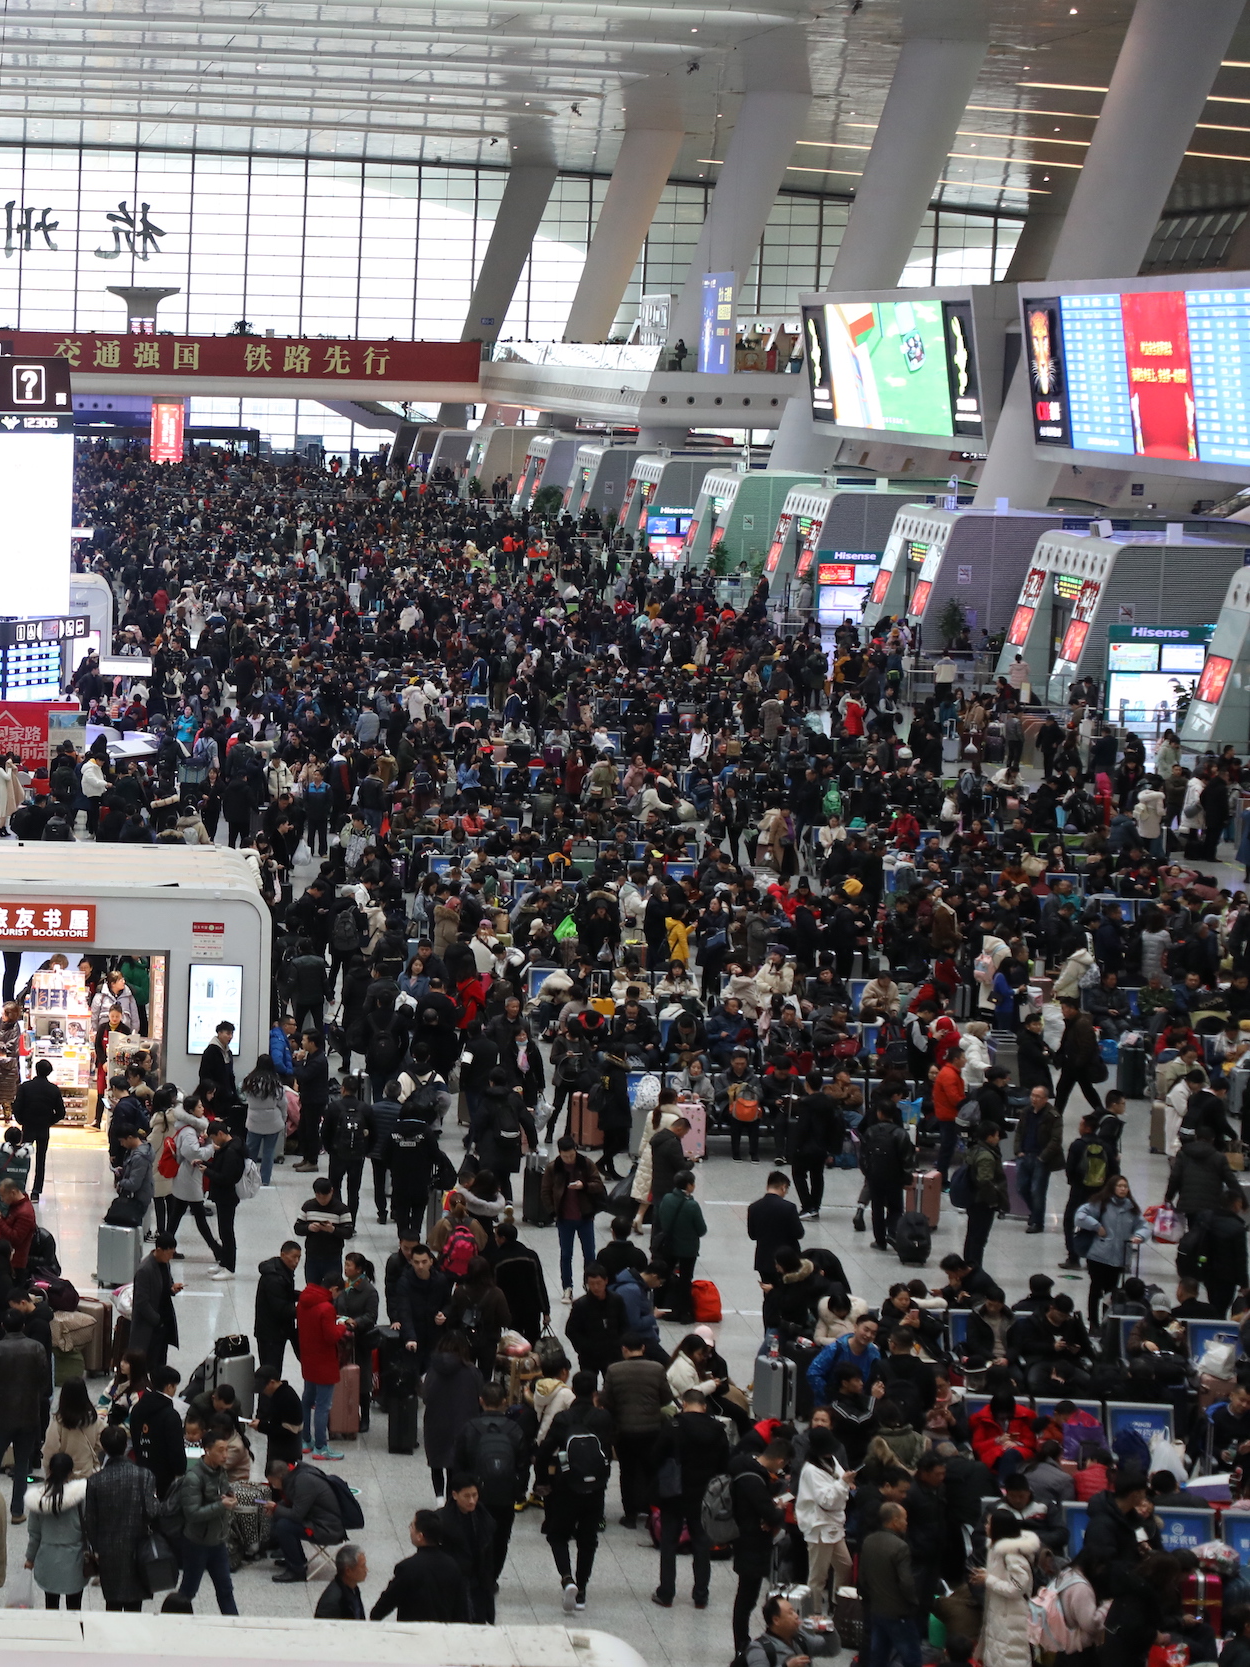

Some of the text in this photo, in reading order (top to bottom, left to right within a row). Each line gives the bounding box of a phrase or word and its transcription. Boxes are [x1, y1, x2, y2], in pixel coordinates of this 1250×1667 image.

[53, 338, 200, 371] 交通强国
[244, 343, 391, 375] 铁路先行
[23, 417, 59, 429] 12306
[660, 506, 694, 514] Hisense
[834, 551, 877, 561] Hisense
[1131, 626, 1190, 638] Hisense
[32, 929, 88, 938] BOOKSTORE
